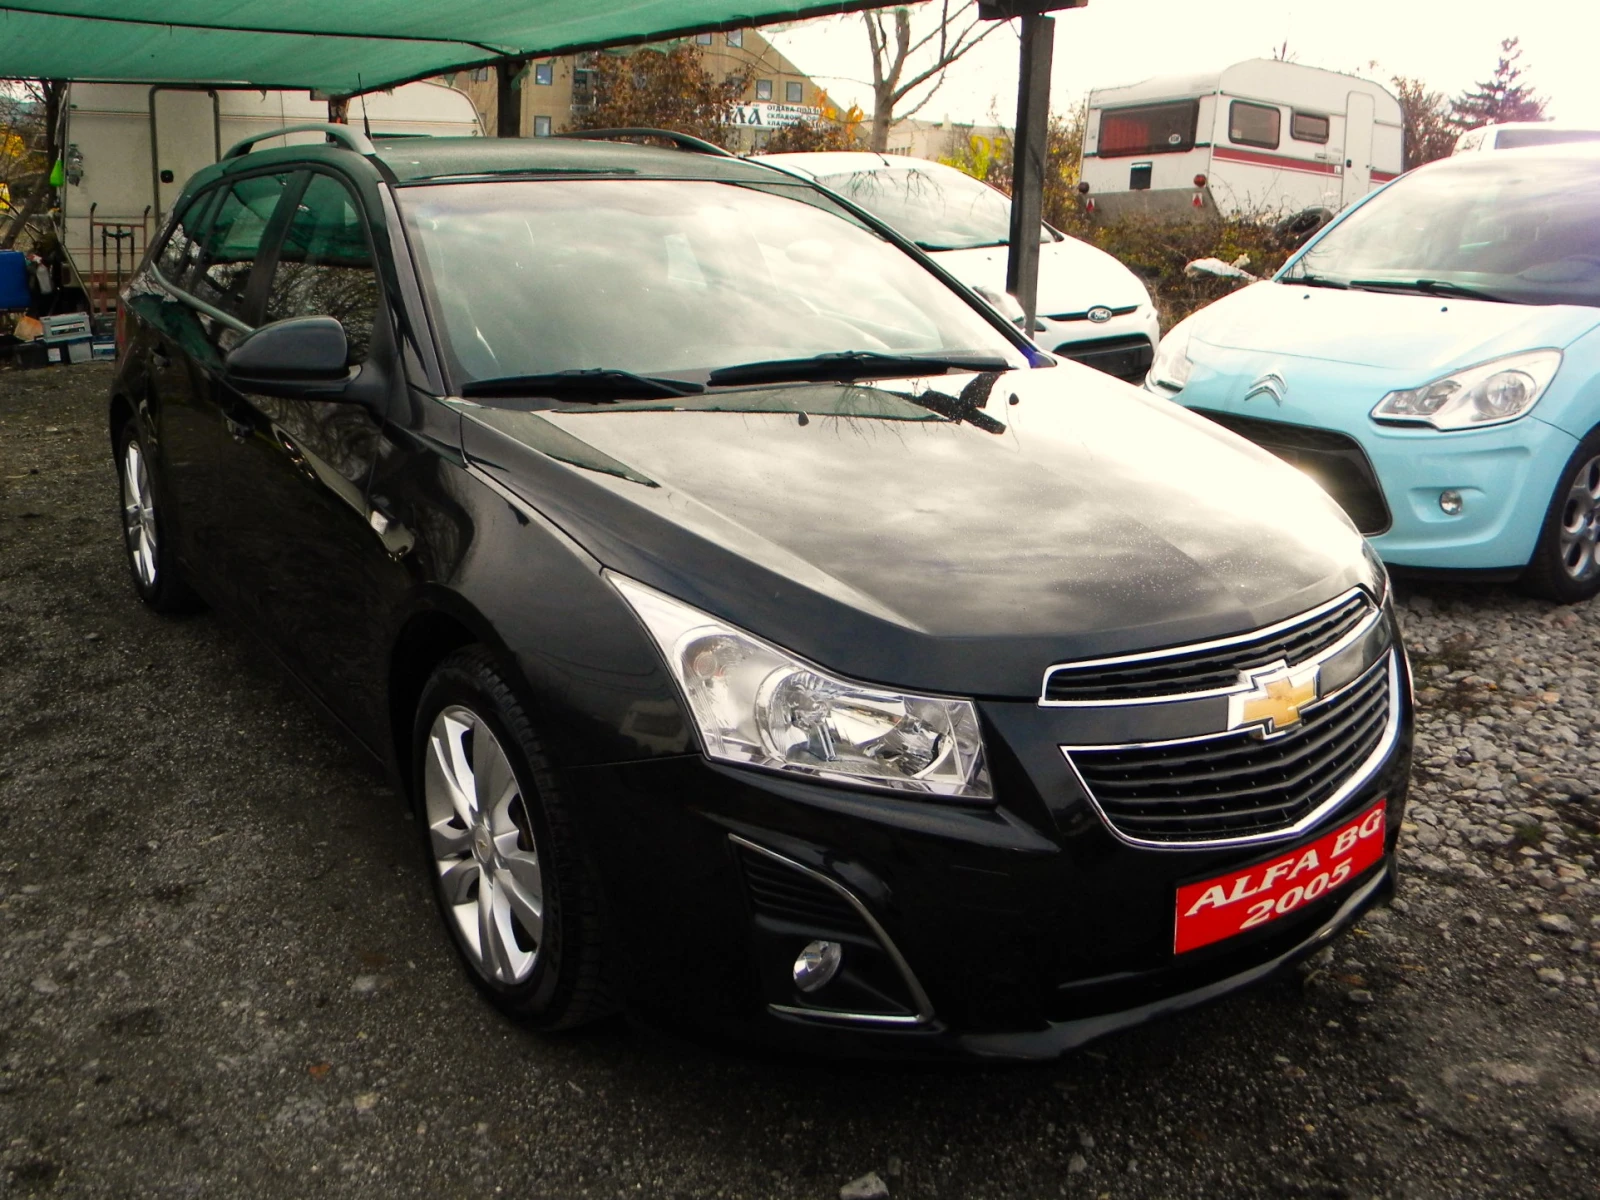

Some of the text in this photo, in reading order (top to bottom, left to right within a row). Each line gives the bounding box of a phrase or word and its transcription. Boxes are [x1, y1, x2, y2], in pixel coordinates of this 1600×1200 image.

[766, 104, 795, 113] ОТДАВА
[1184, 808, 1383, 917] ALFA BG
[1239, 857, 1353, 930] 2005
